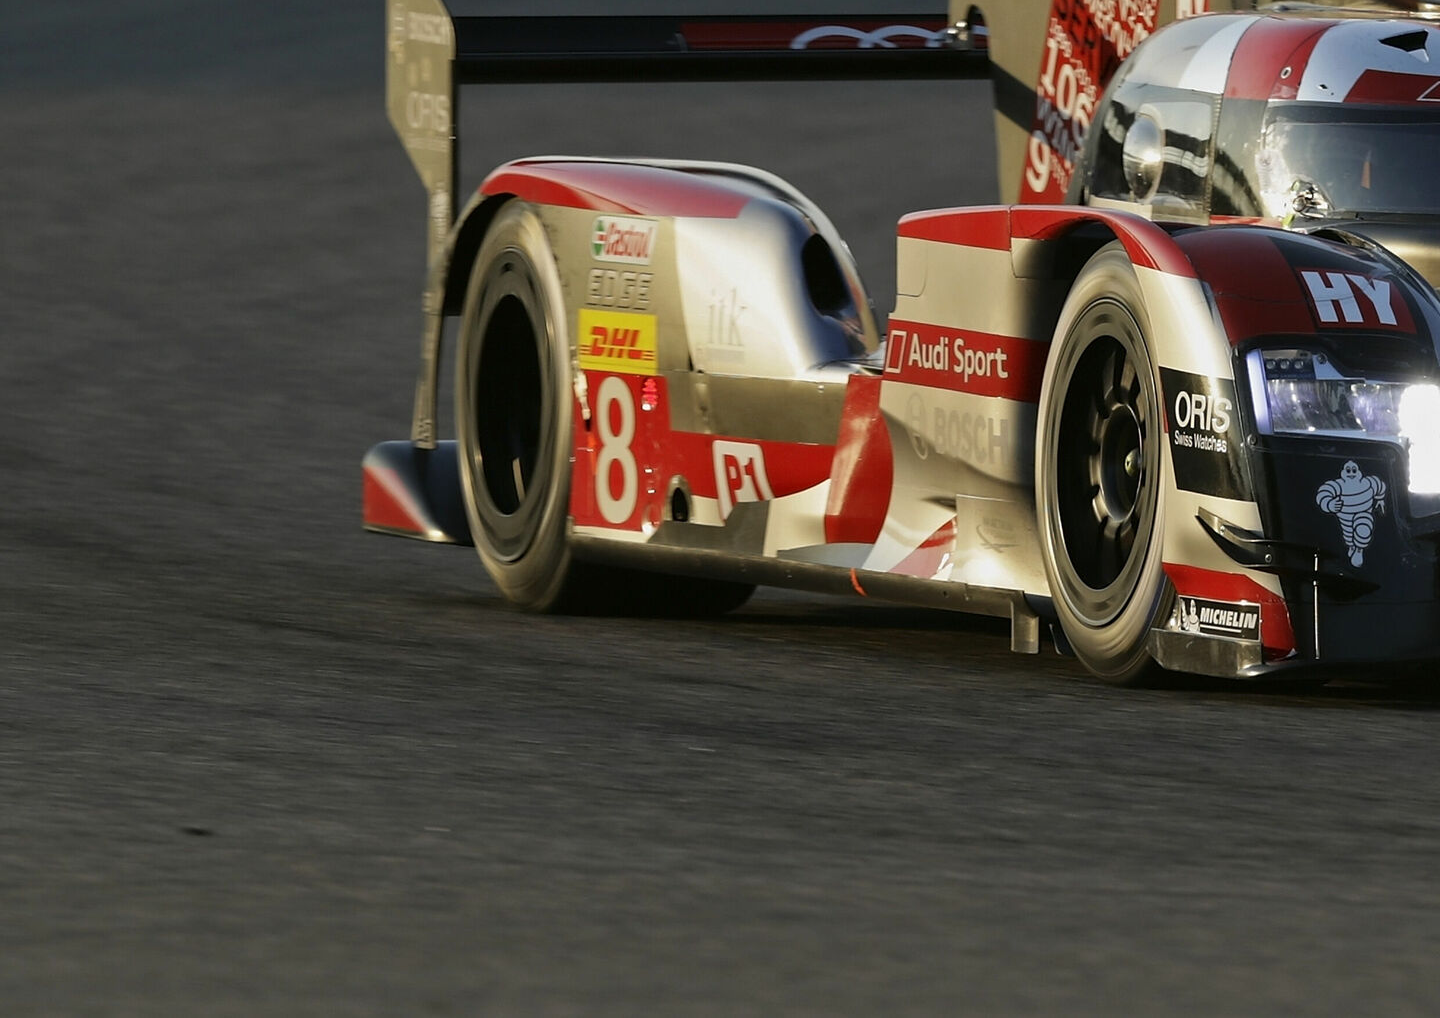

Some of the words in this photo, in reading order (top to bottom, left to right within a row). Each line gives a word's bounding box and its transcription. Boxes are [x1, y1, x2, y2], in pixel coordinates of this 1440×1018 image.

[1026, 130, 1051, 193] 9
[603, 222, 653, 258] Castrol
[585, 268, 654, 311] EDGE
[1302, 271, 1397, 326] HY
[588, 326, 642, 360] DHL
[908, 339, 949, 372] Audi
[953, 339, 1008, 381] Sport
[1175, 391, 1232, 434] ORIS
[595, 377, 638, 524] 8
[934, 407, 1009, 464] BOSCH
[1174, 430, 1193, 448] Swiss
[1193, 433, 1227, 453] Watches
[721, 453, 765, 508] P1
[1200, 607, 1258, 629] MICHELIN
